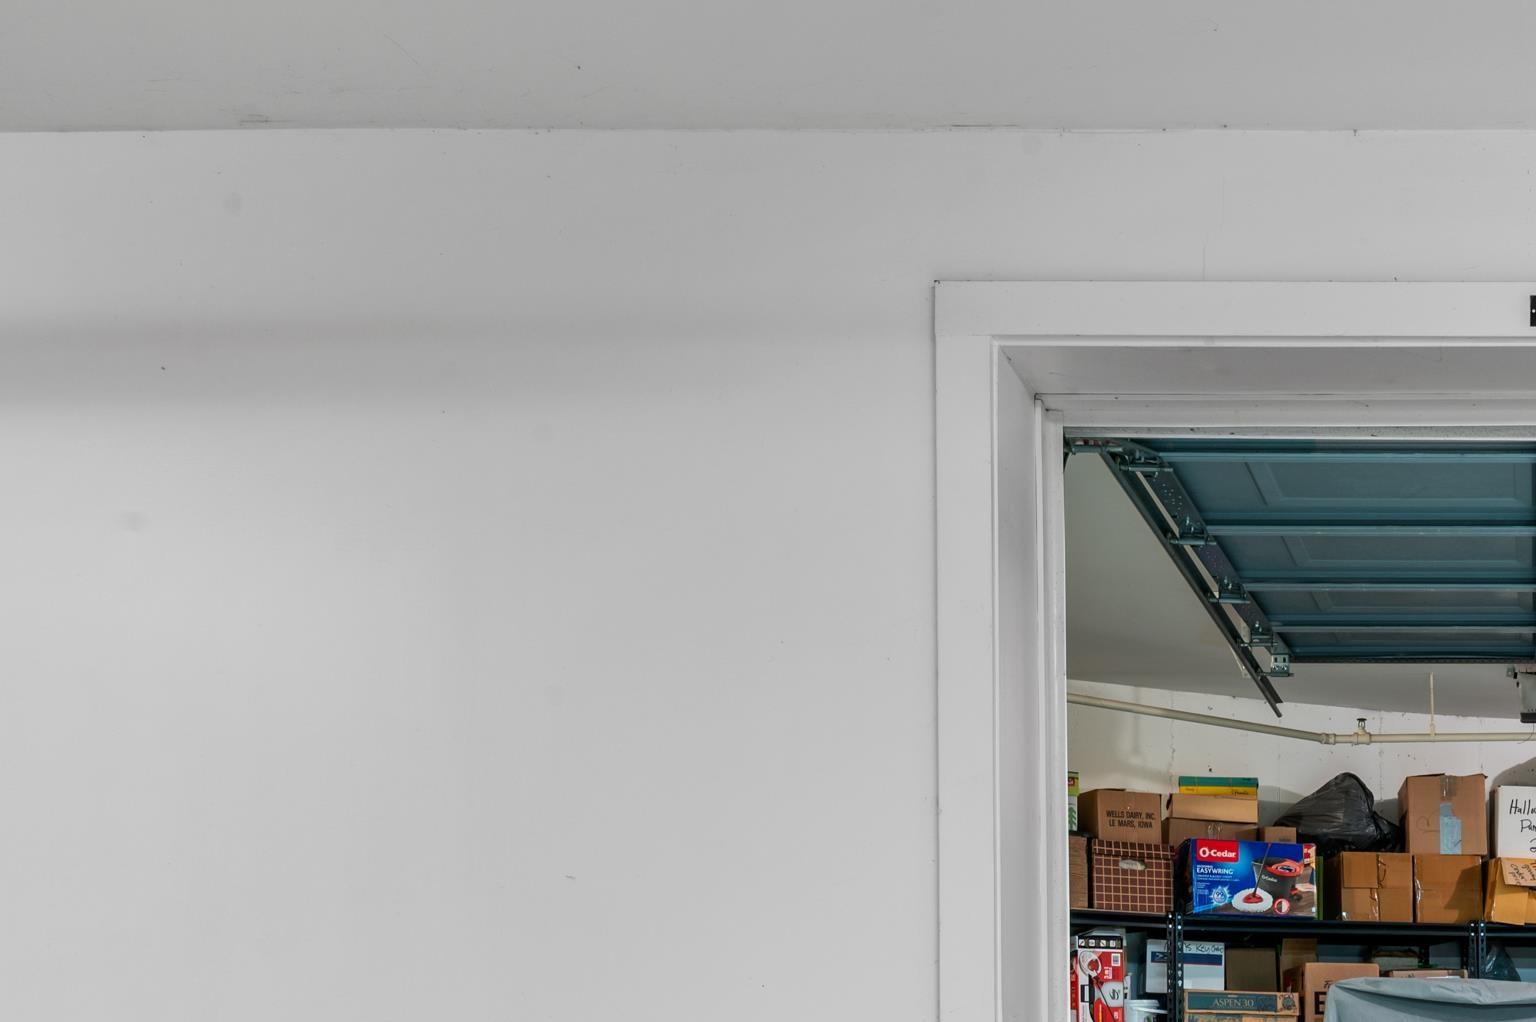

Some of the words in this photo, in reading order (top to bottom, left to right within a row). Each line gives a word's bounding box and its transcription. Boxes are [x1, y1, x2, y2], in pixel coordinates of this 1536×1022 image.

[1106, 810, 1125, 818] WELLS
[1196, 867, 1234, 875] EASYWRING
[1213, 999, 1241, 1007] ASPEN
